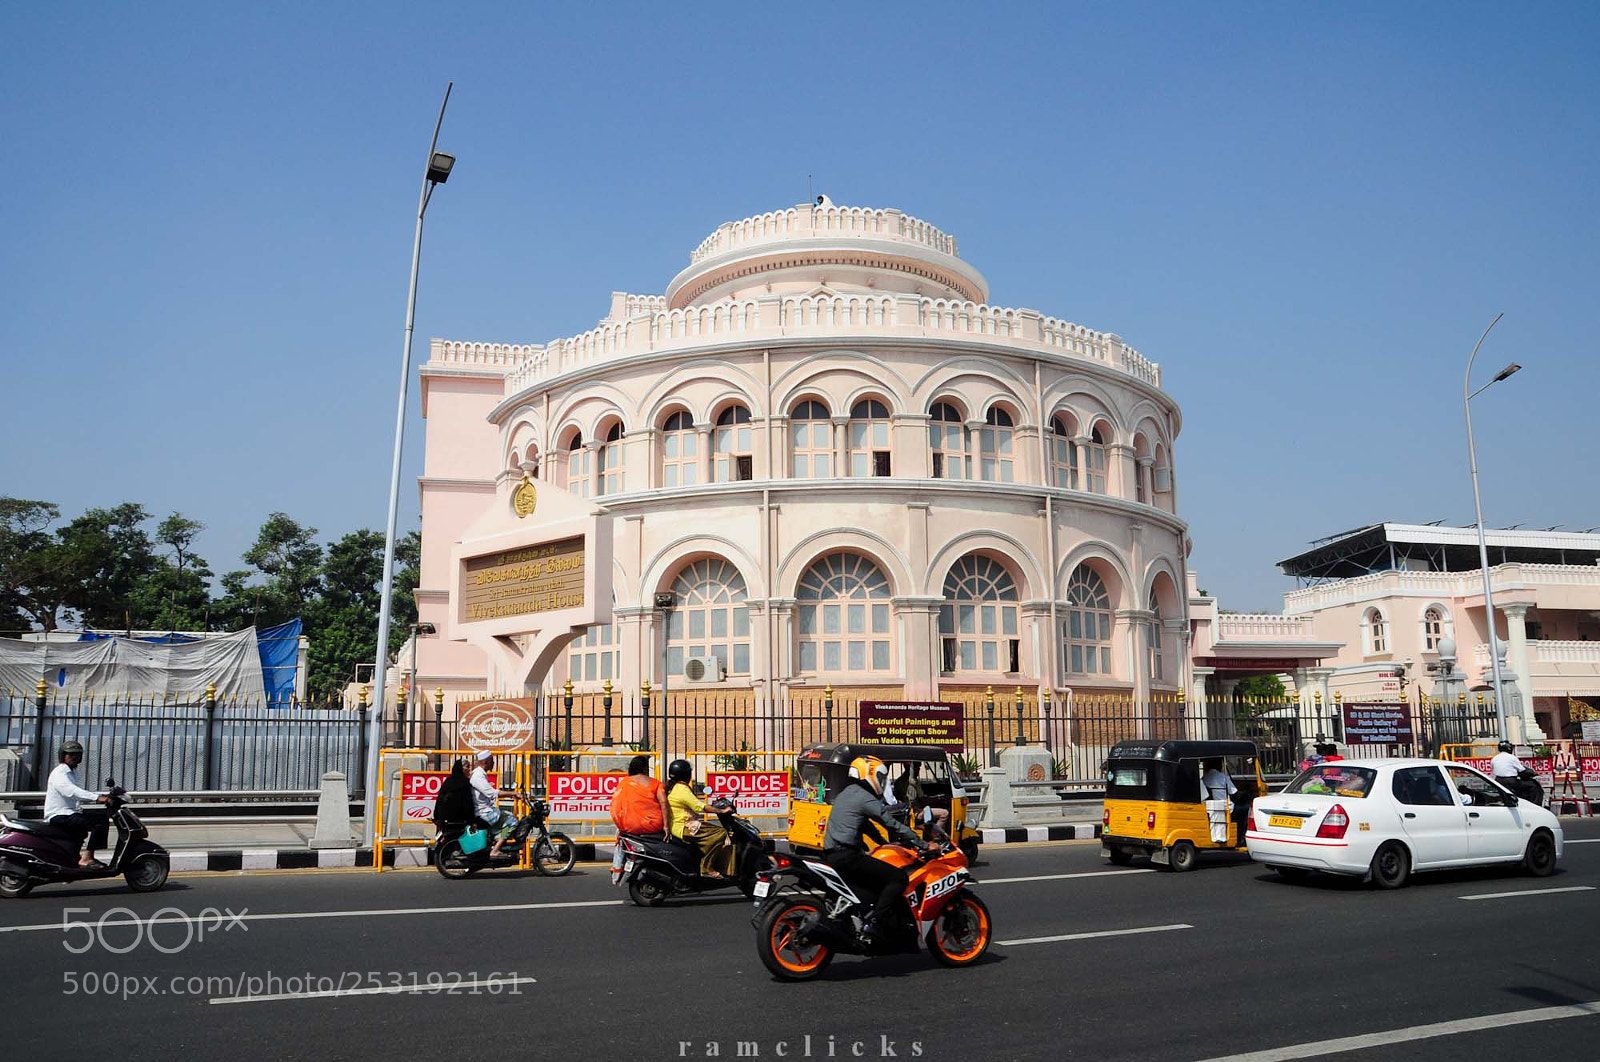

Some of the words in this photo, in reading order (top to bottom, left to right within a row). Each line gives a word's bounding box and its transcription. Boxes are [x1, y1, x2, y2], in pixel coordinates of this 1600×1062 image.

[470, 595, 543, 618] Vivekananda
[868, 718, 904, 726] Colourful
[905, 718, 940, 727] Paintings
[941, 718, 956, 726] and
[876, 727, 888, 735] 2D
[889, 727, 926, 737] Hologram
[861, 737, 879, 745] from
[881, 737, 905, 745] Vedas
[906, 737, 914, 745] to
[915, 737, 964, 745] Vivekananda
[557, 776, 622, 794] POLIC
[714, 775, 780, 792] POLICE
[734, 799, 780, 809] hindra
